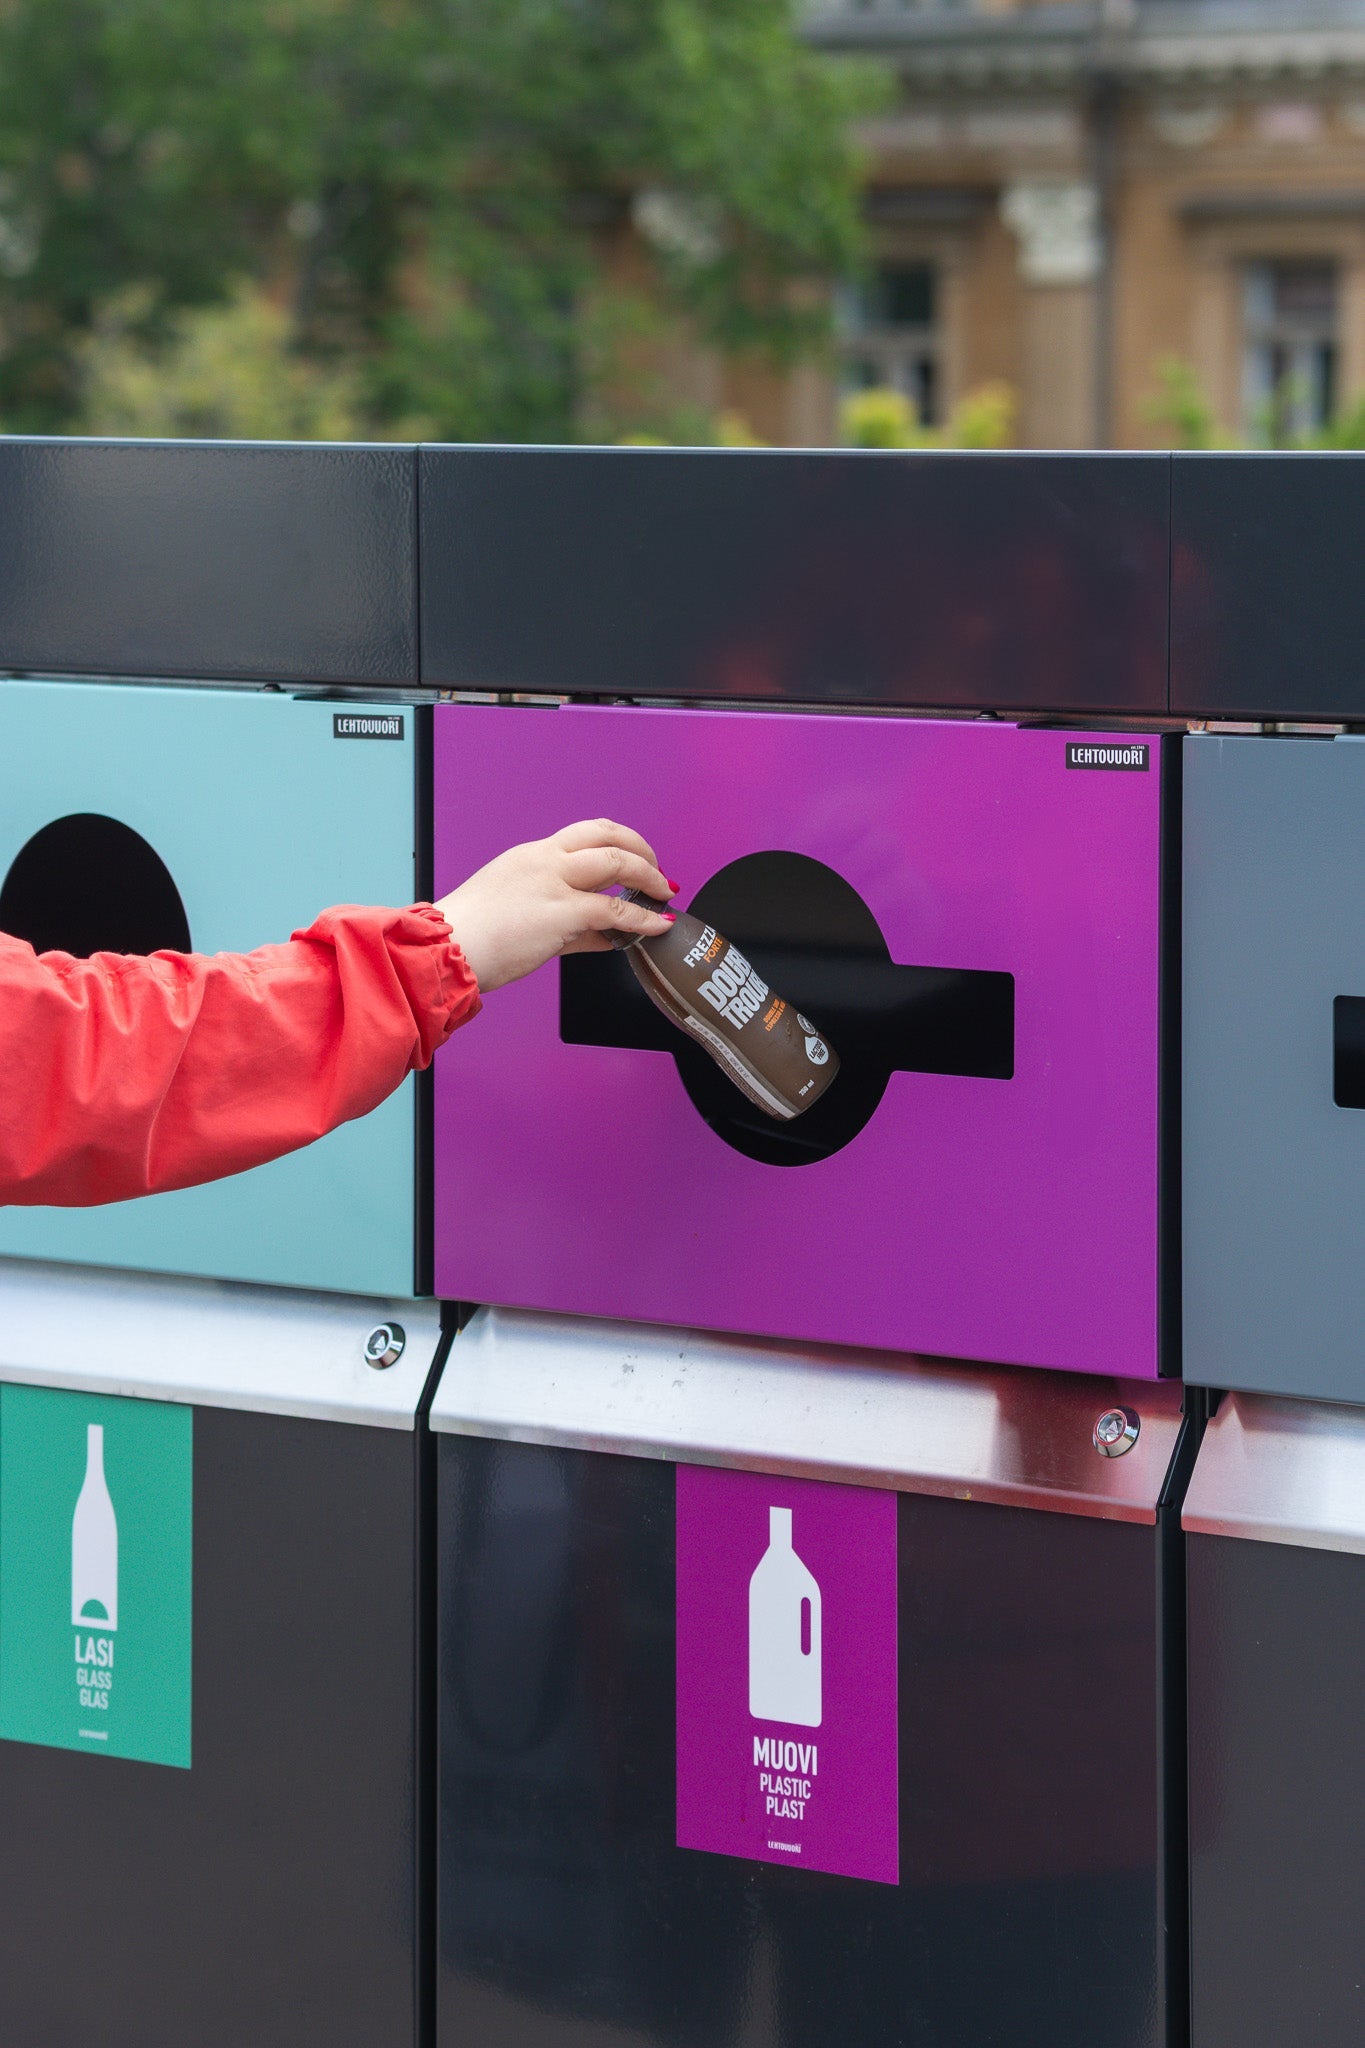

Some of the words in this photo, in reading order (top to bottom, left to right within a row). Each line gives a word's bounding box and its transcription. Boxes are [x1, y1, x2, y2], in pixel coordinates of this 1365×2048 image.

[338, 719, 399, 734] LEHTOVUORI
[1071, 748, 1143, 765] LEHTOVUORI
[703, 937, 723, 963] FORTE
[720, 969, 769, 1030] TROUB
[75, 1635, 114, 1668] LASI
[76, 1667, 112, 1690] GLASS
[80, 1687, 109, 1710] GLAS
[753, 1736, 818, 1776] MUOVI
[760, 1772, 811, 1800] PLASTIC
[766, 1796, 805, 1820] PLAST
